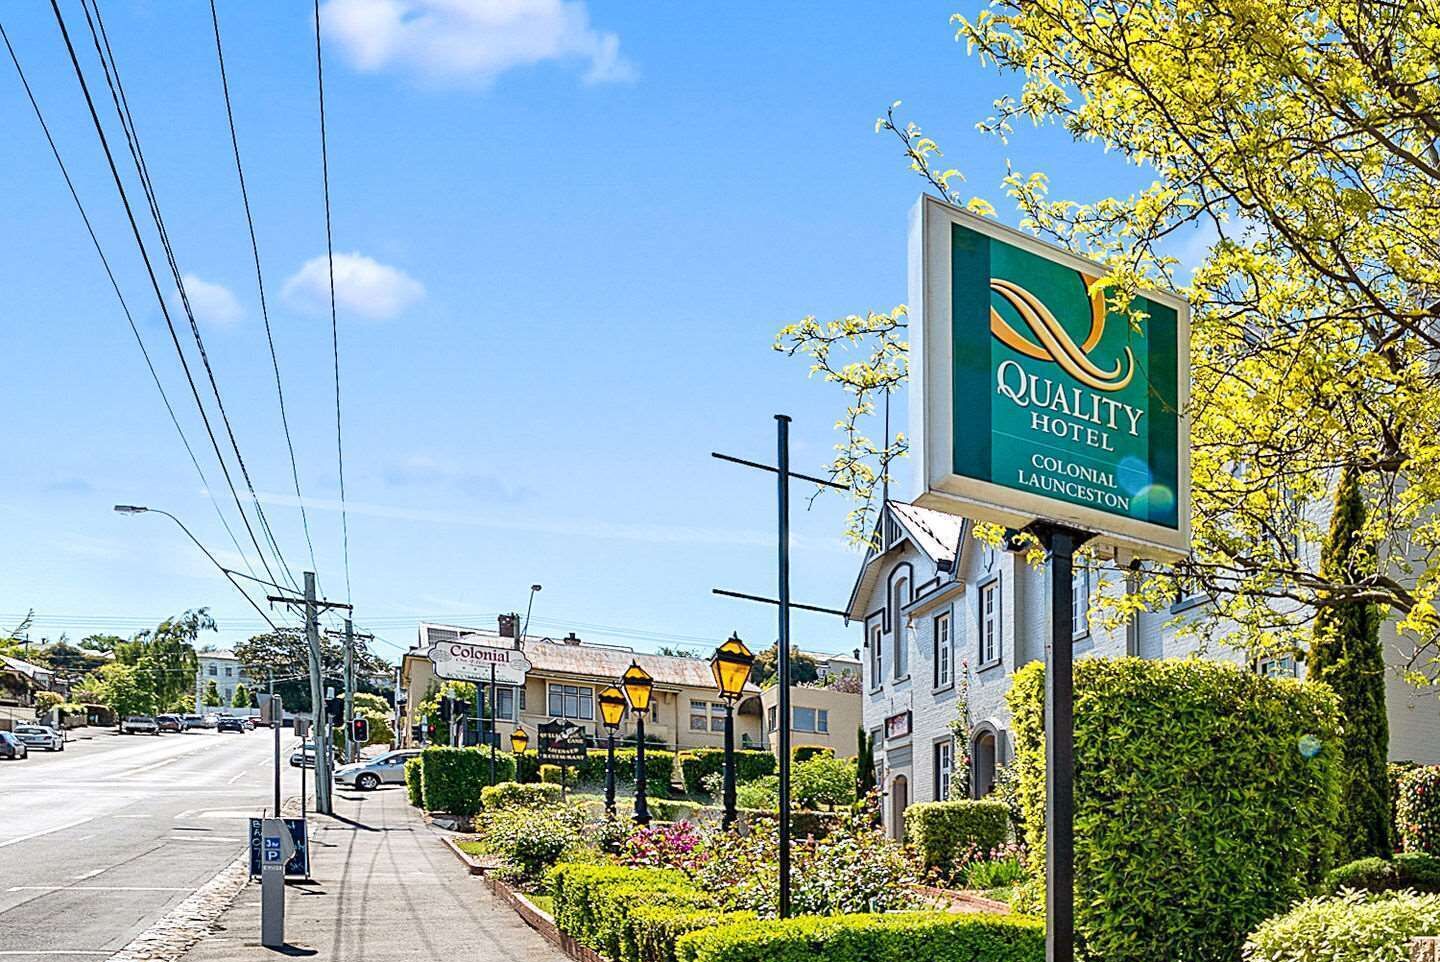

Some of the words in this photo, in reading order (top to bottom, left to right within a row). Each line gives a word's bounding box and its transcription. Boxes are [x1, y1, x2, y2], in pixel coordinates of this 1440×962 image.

[997, 360, 1144, 436] QUALITY
[1031, 411, 1114, 452] HOTEL
[1018, 470, 1129, 510] LAUNCESTON
[1031, 454, 1118, 489] COLONIAL
[450, 645, 510, 663] Colonial
[268, 851, 278, 861] P
